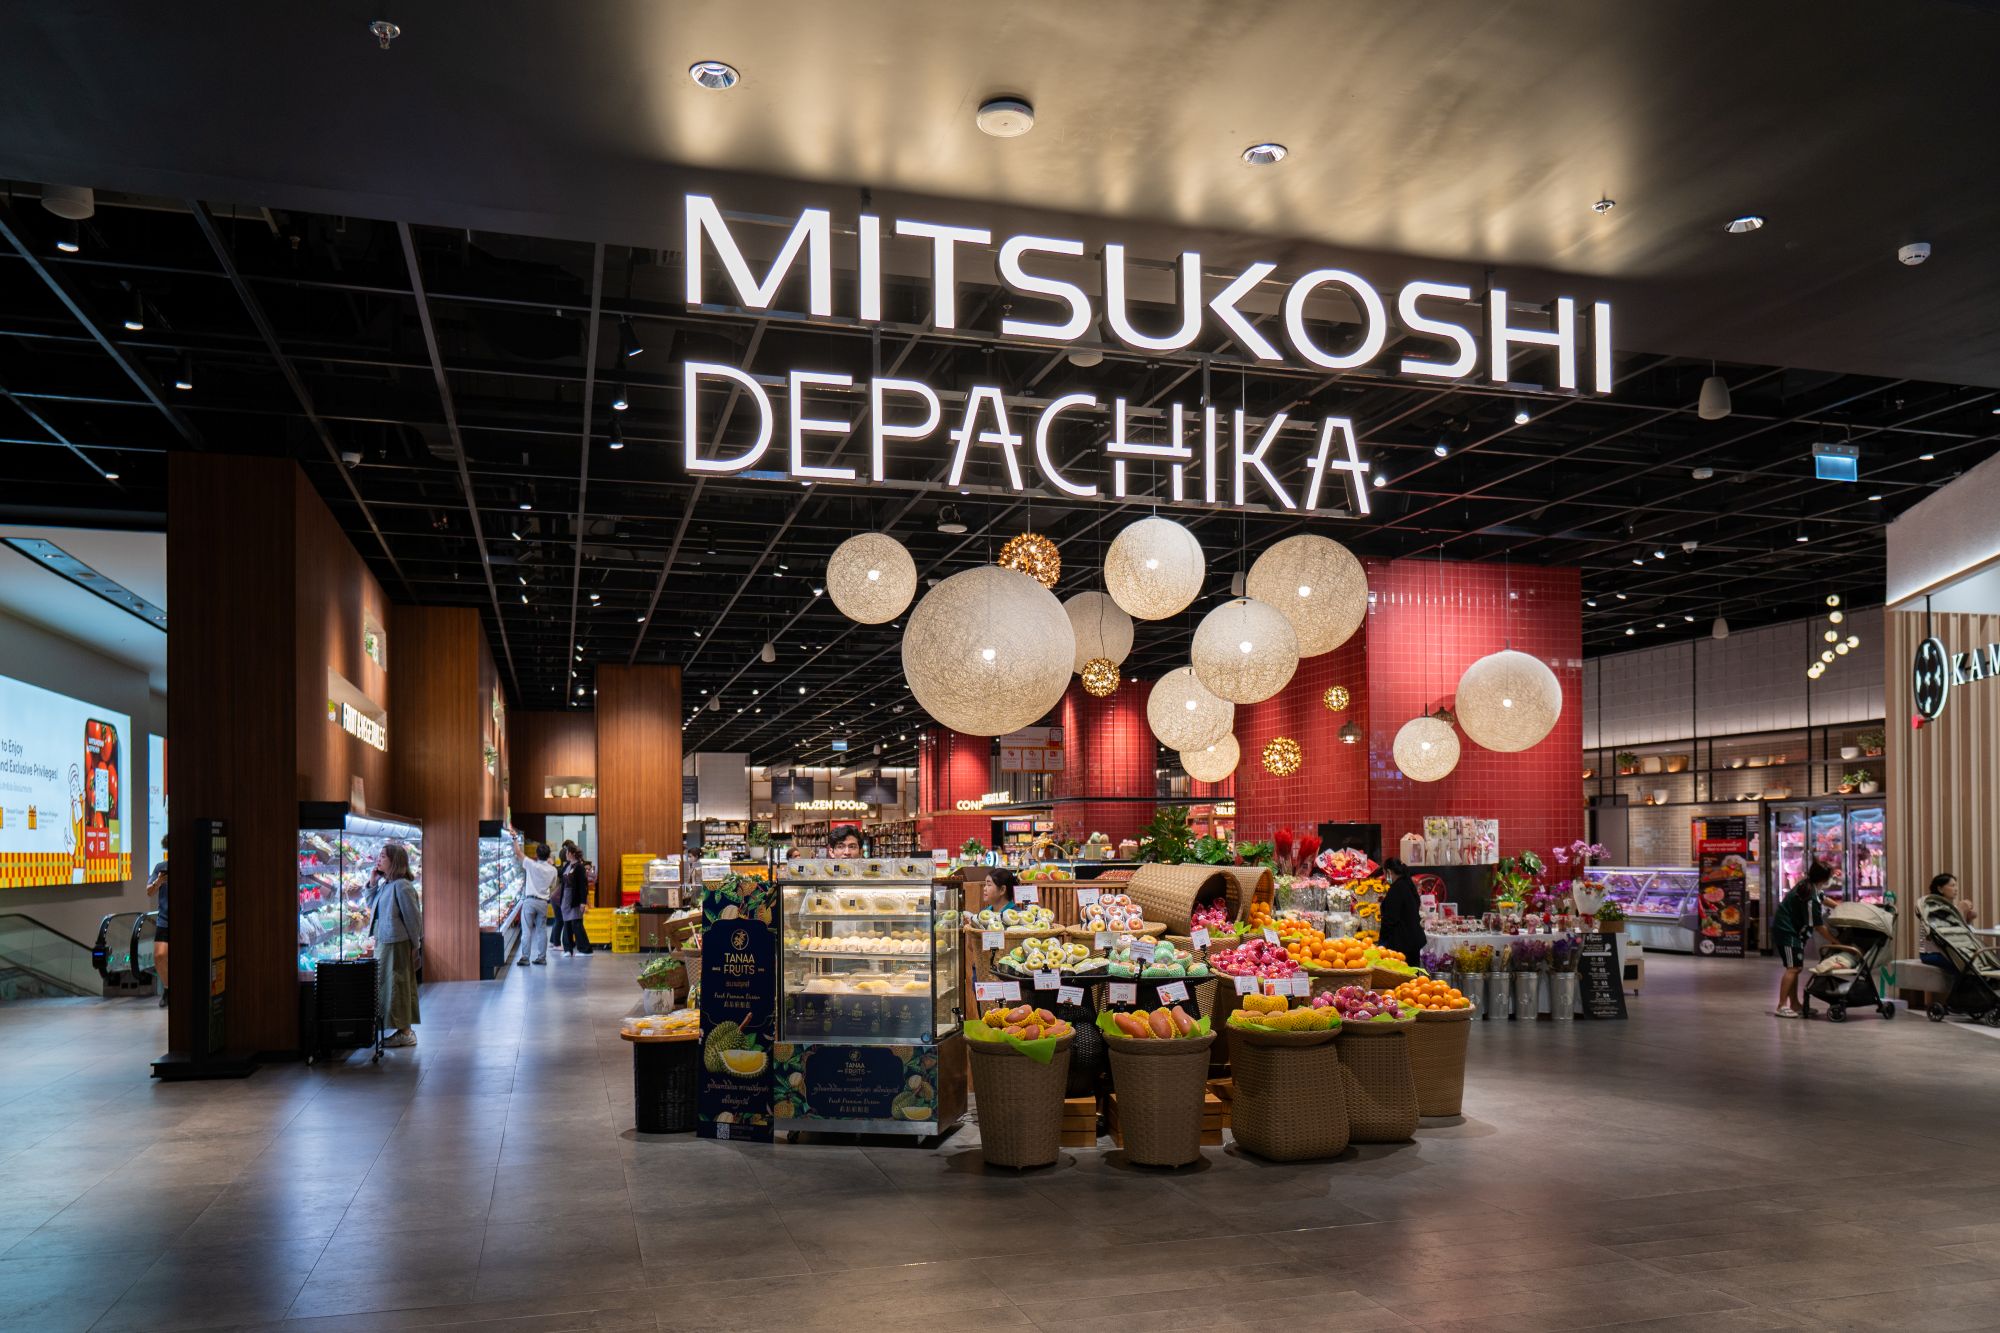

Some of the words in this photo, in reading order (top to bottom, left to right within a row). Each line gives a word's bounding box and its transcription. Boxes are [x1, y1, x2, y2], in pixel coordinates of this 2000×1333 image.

[686, 195, 1612, 394] MITSUKOSHI
[684, 361, 1371, 515] DEPACHIKA
[8, 739, 23, 757] Enjoy
[9, 759, 33, 777] Exclusive
[724, 952, 755, 964] TANAA
[723, 964, 755, 977] FRUITS
[844, 1068, 866, 1076] FRUITS
